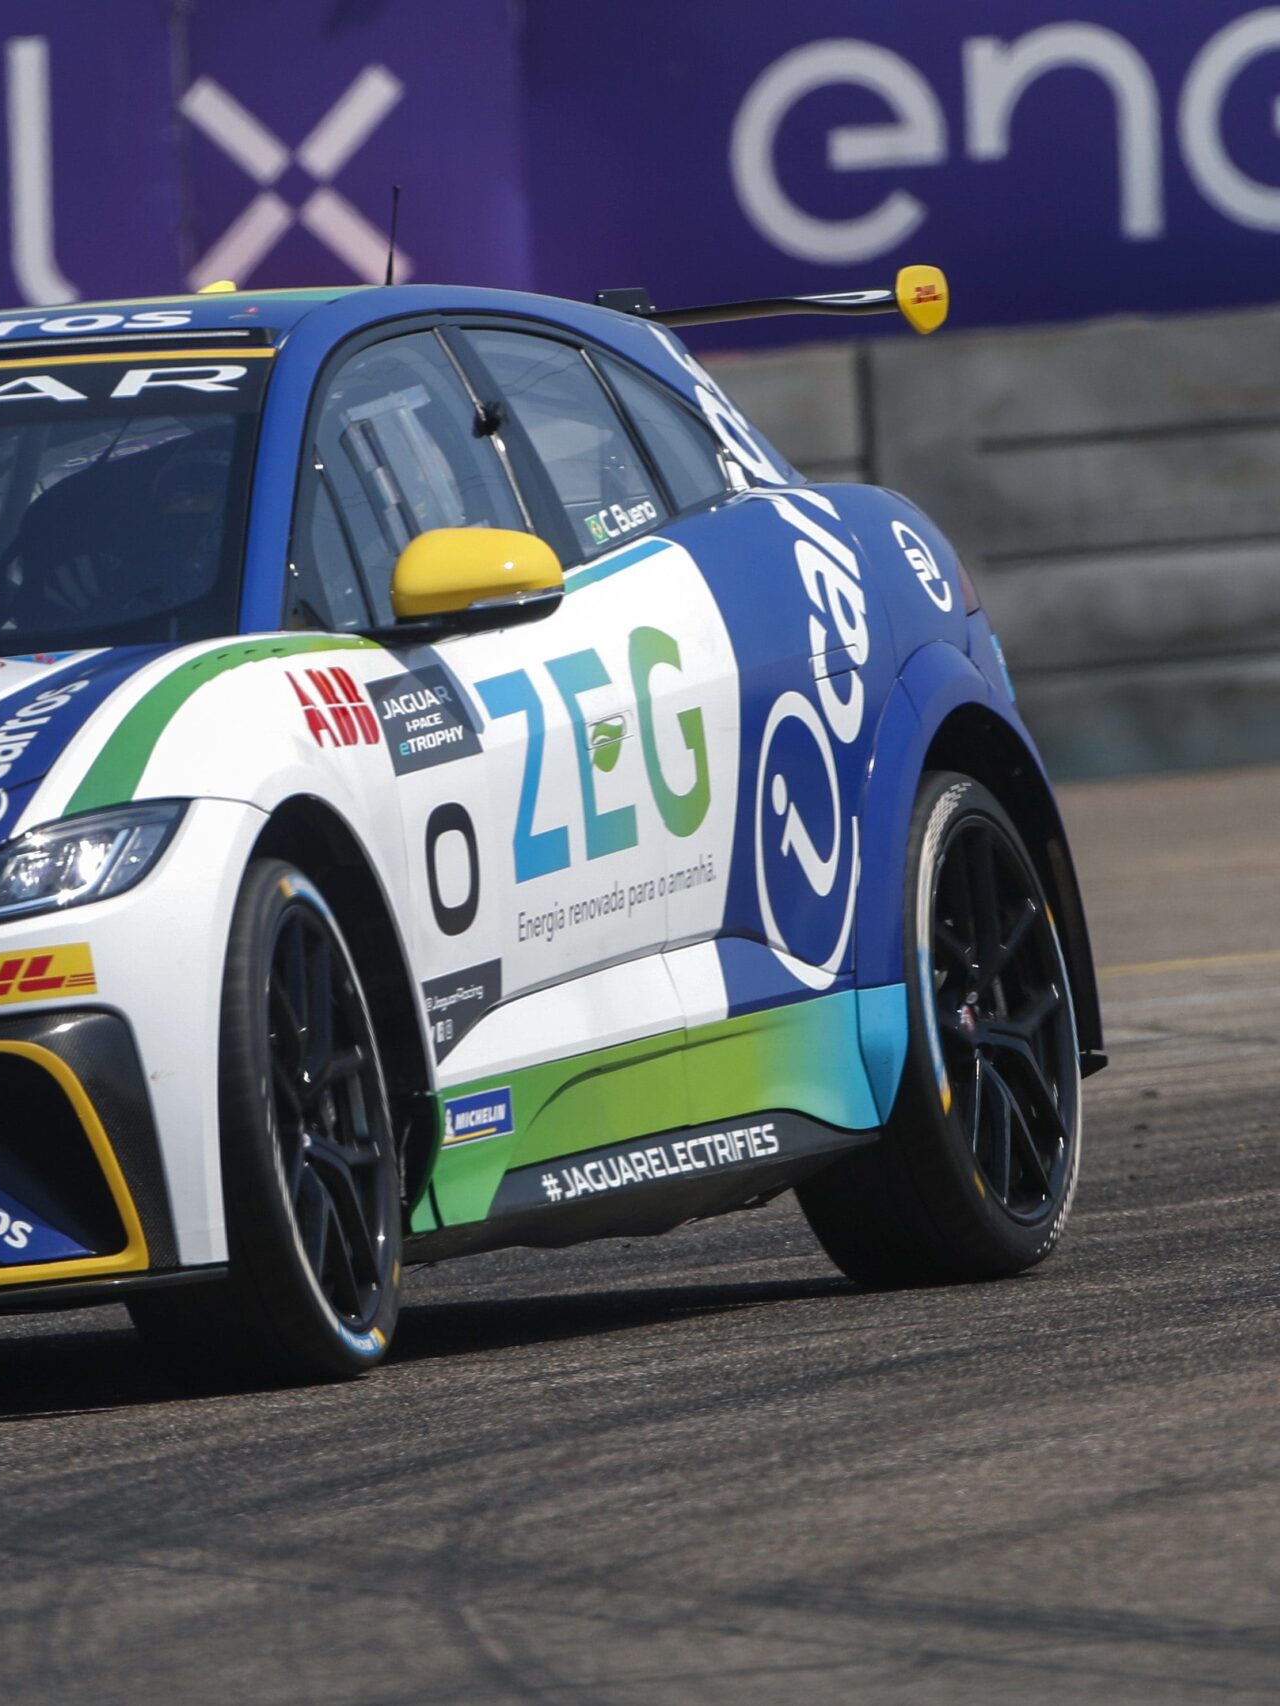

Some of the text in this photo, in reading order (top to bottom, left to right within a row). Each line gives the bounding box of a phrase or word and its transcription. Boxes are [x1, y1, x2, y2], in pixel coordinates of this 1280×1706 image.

[284, 667, 380, 748] ABB
[382, 685, 452, 720] JAGUAR
[399, 725, 464, 757] eTROPHY
[473, 625, 711, 884] ZEG
[517, 902, 565, 943] Energia
[568, 880, 625, 926] renovada
[627, 879, 656, 918] para
[658, 876, 667, 897] o
[454, 1103, 506, 1130] MICHELIN
[541, 1123, 780, 1202] #JAGUARELECTRIFIES
